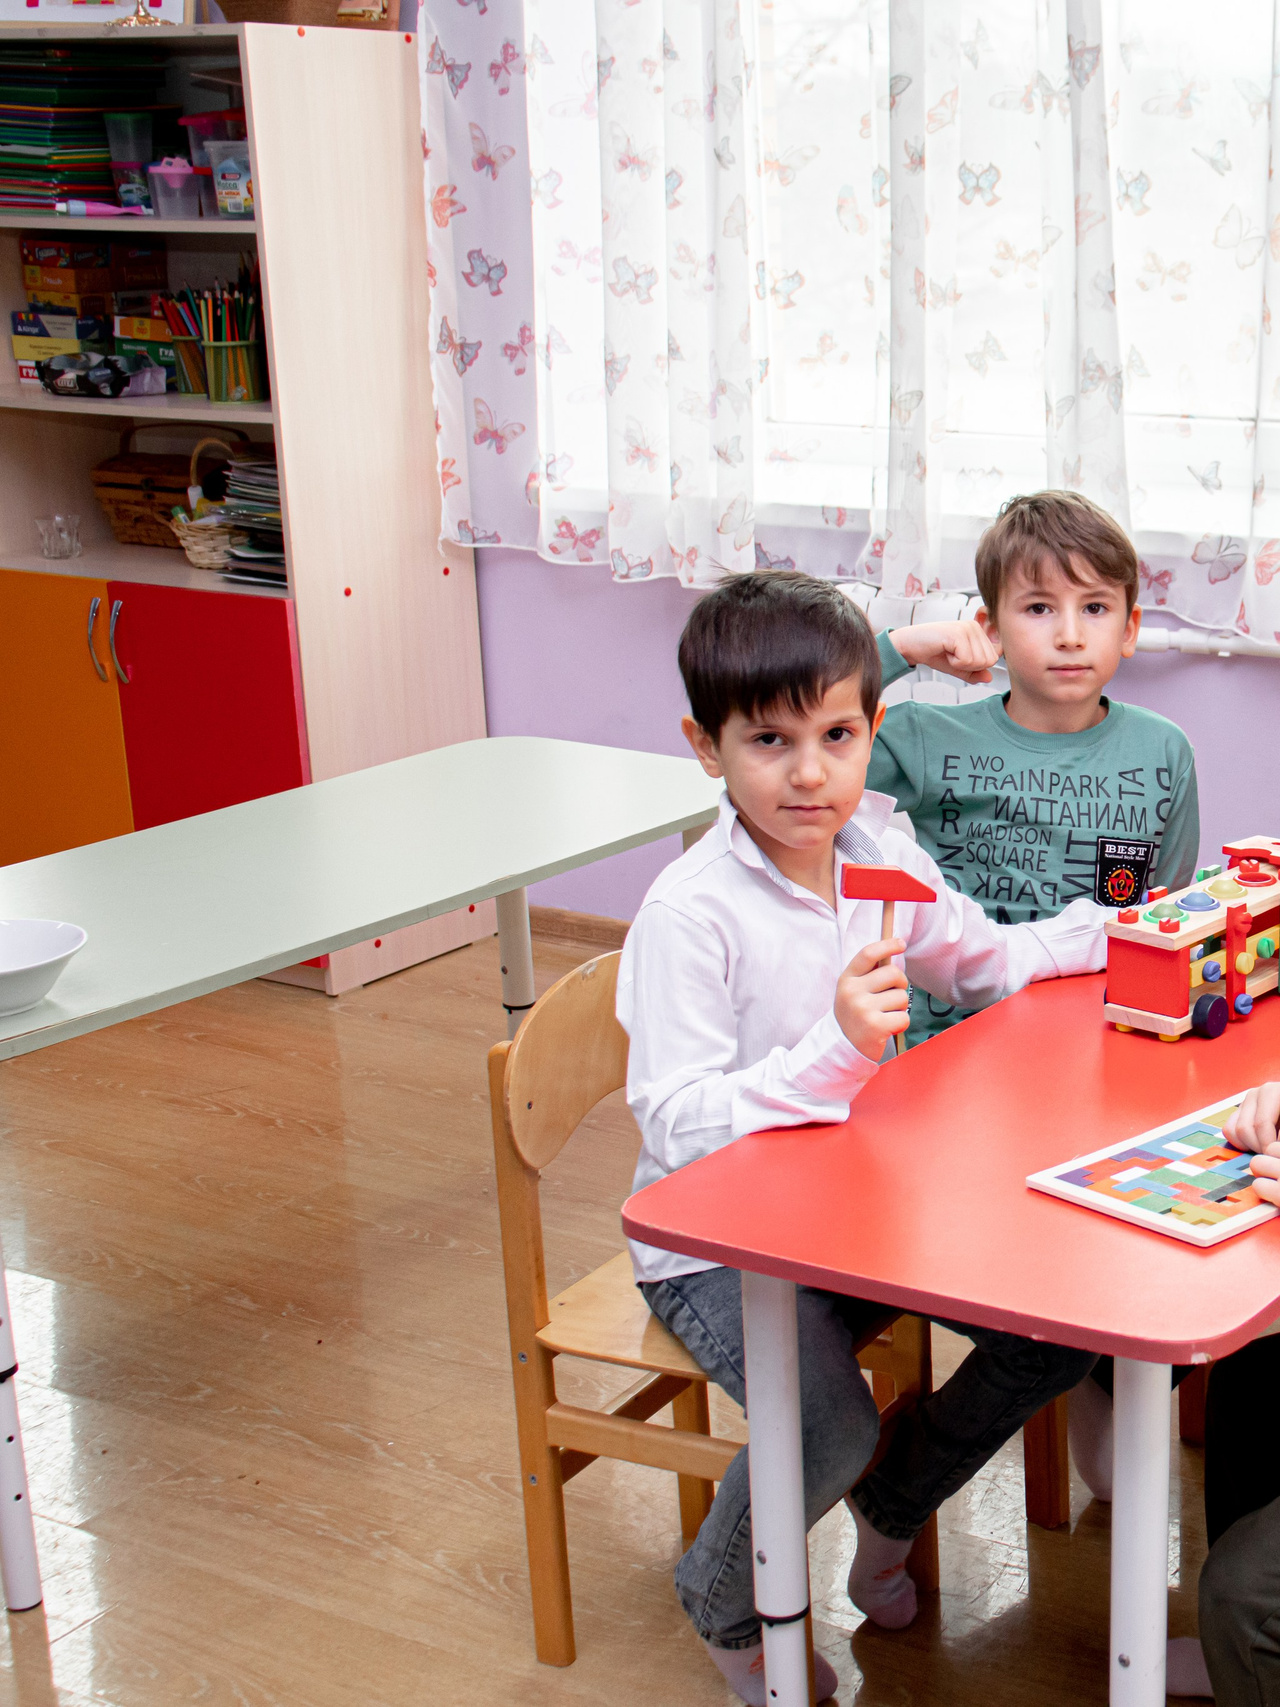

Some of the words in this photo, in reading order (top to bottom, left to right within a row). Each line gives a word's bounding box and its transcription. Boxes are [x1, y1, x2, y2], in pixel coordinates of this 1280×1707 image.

[969, 755, 1004, 773] WO
[965, 821, 1053, 847] MADISON
[965, 841, 1049, 873] SQUARE
[1105, 843, 1148, 856] BEST
